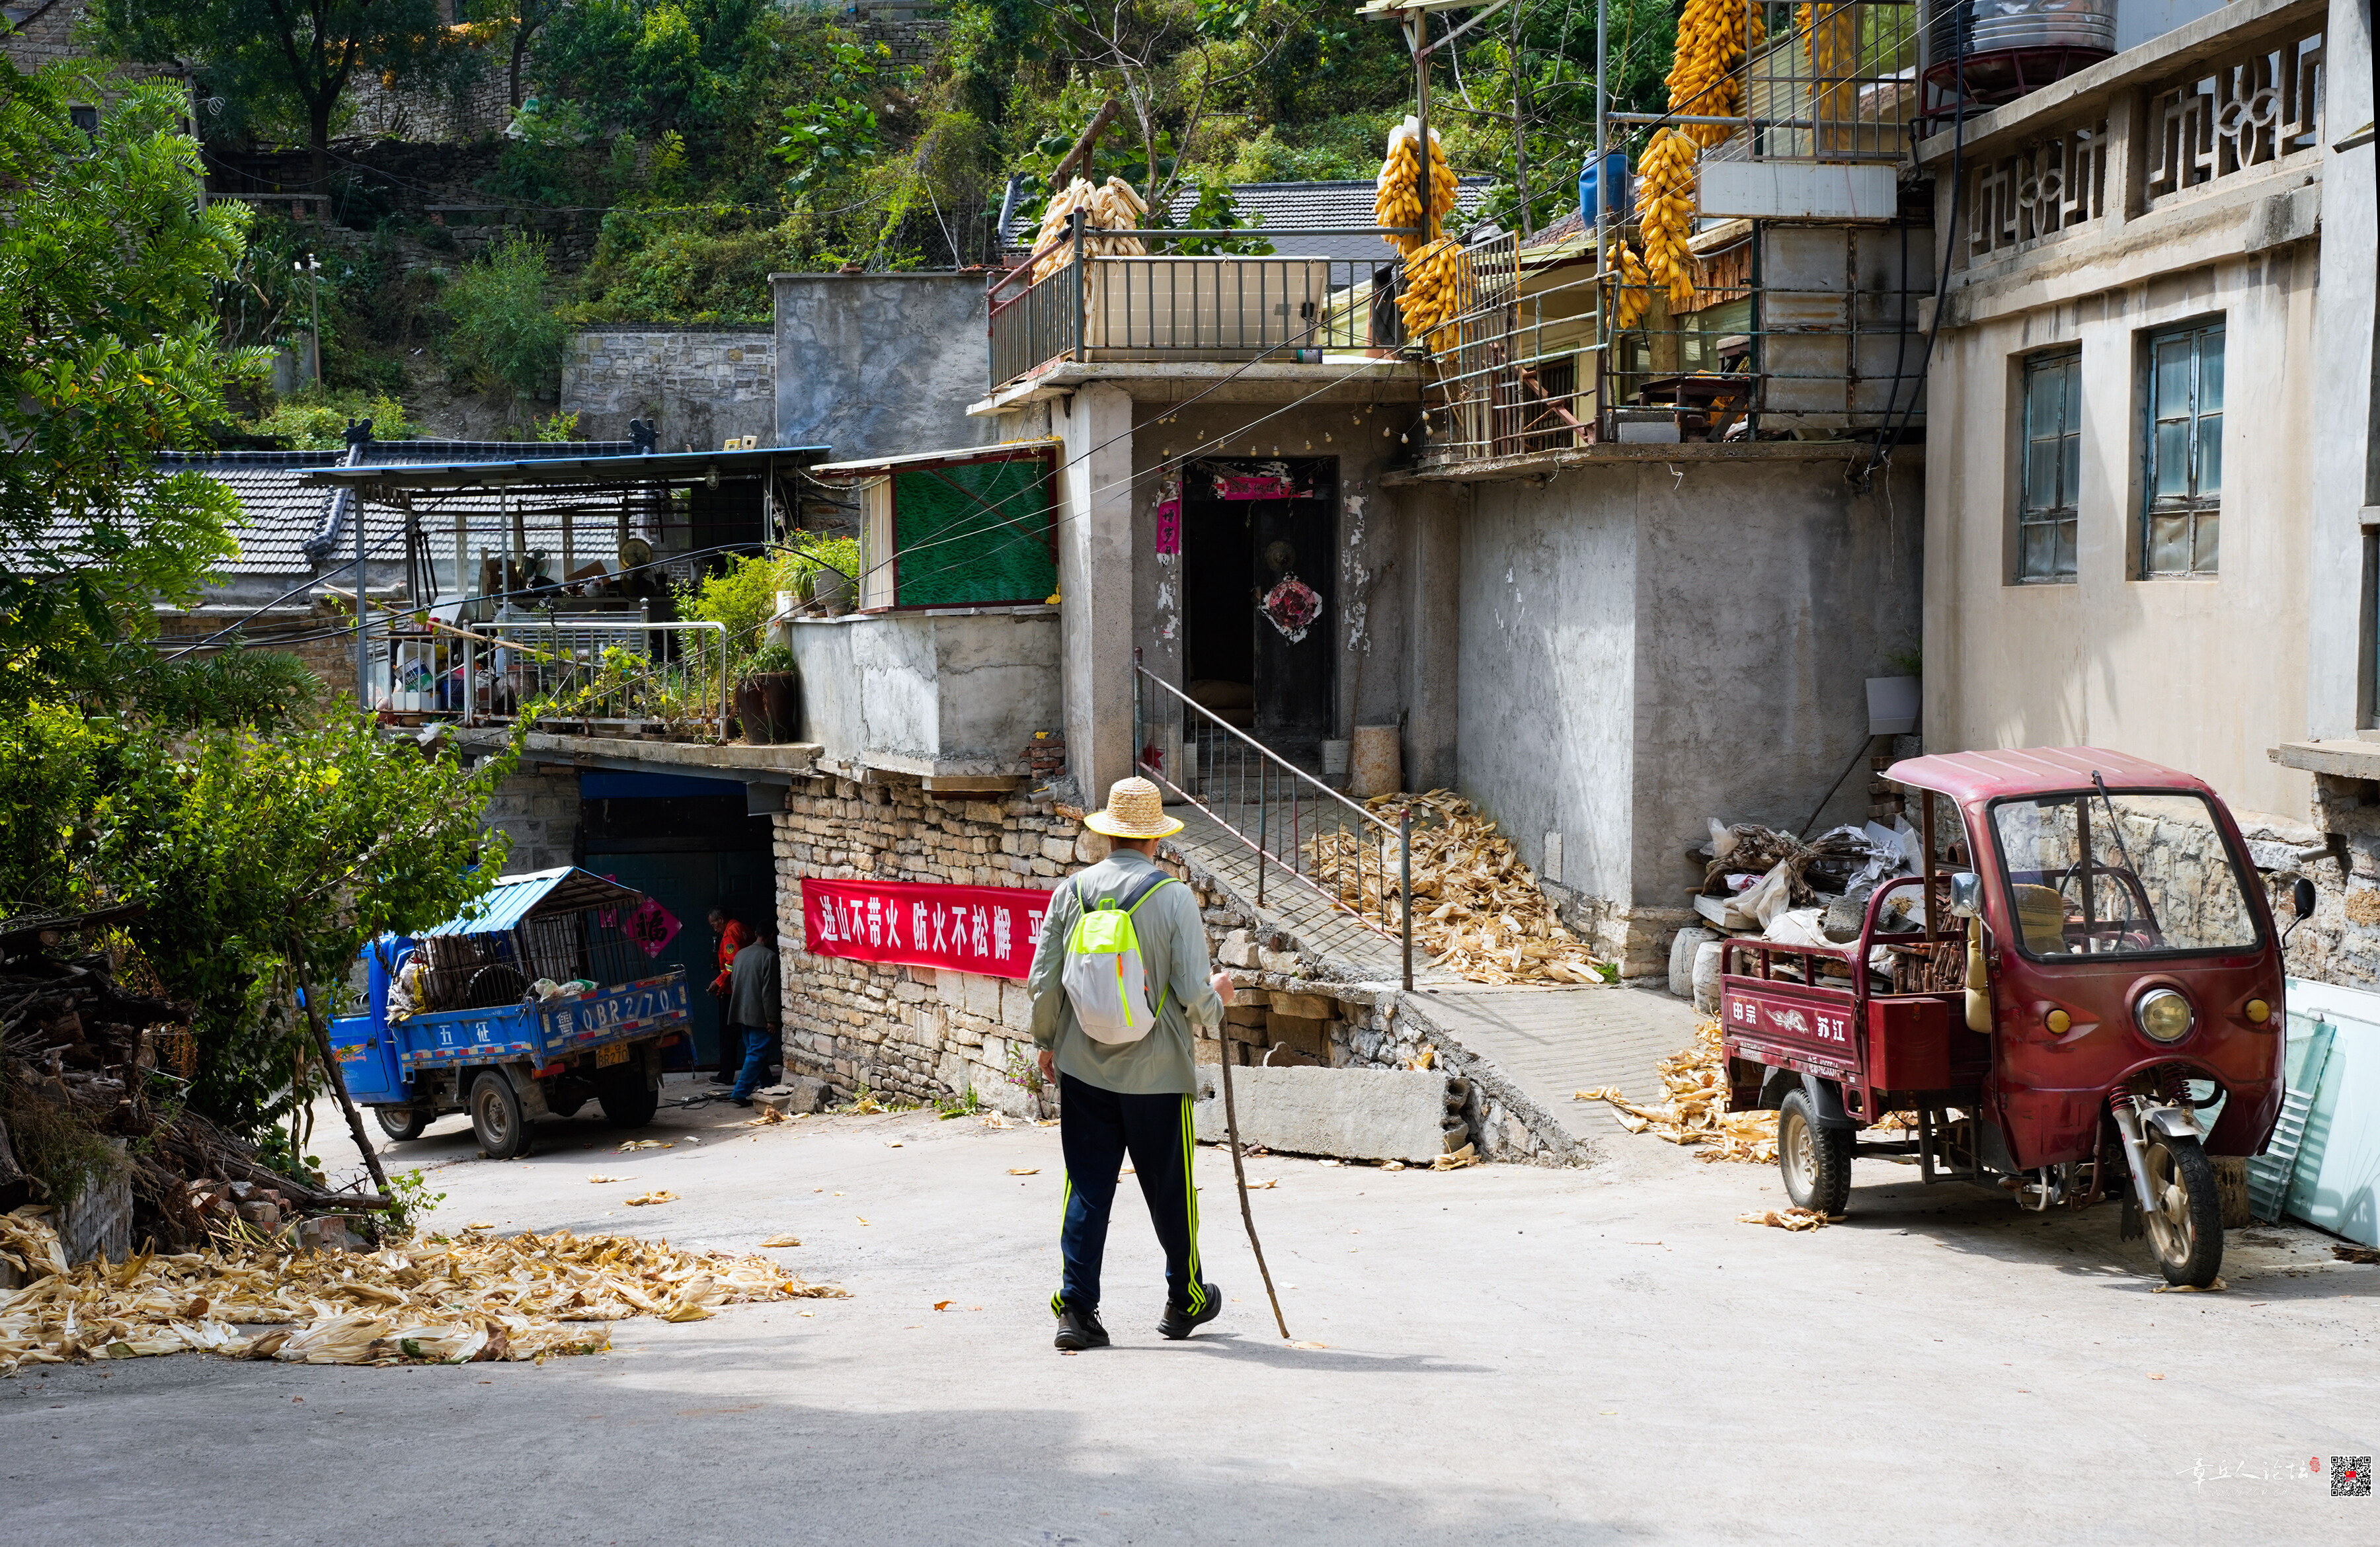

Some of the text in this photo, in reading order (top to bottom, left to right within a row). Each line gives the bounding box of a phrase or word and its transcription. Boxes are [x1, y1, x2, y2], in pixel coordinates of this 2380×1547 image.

[637, 910, 667, 941] 福
[819, 895, 902, 949] 进山不带火
[913, 900, 1012, 961] 防火不松懈
